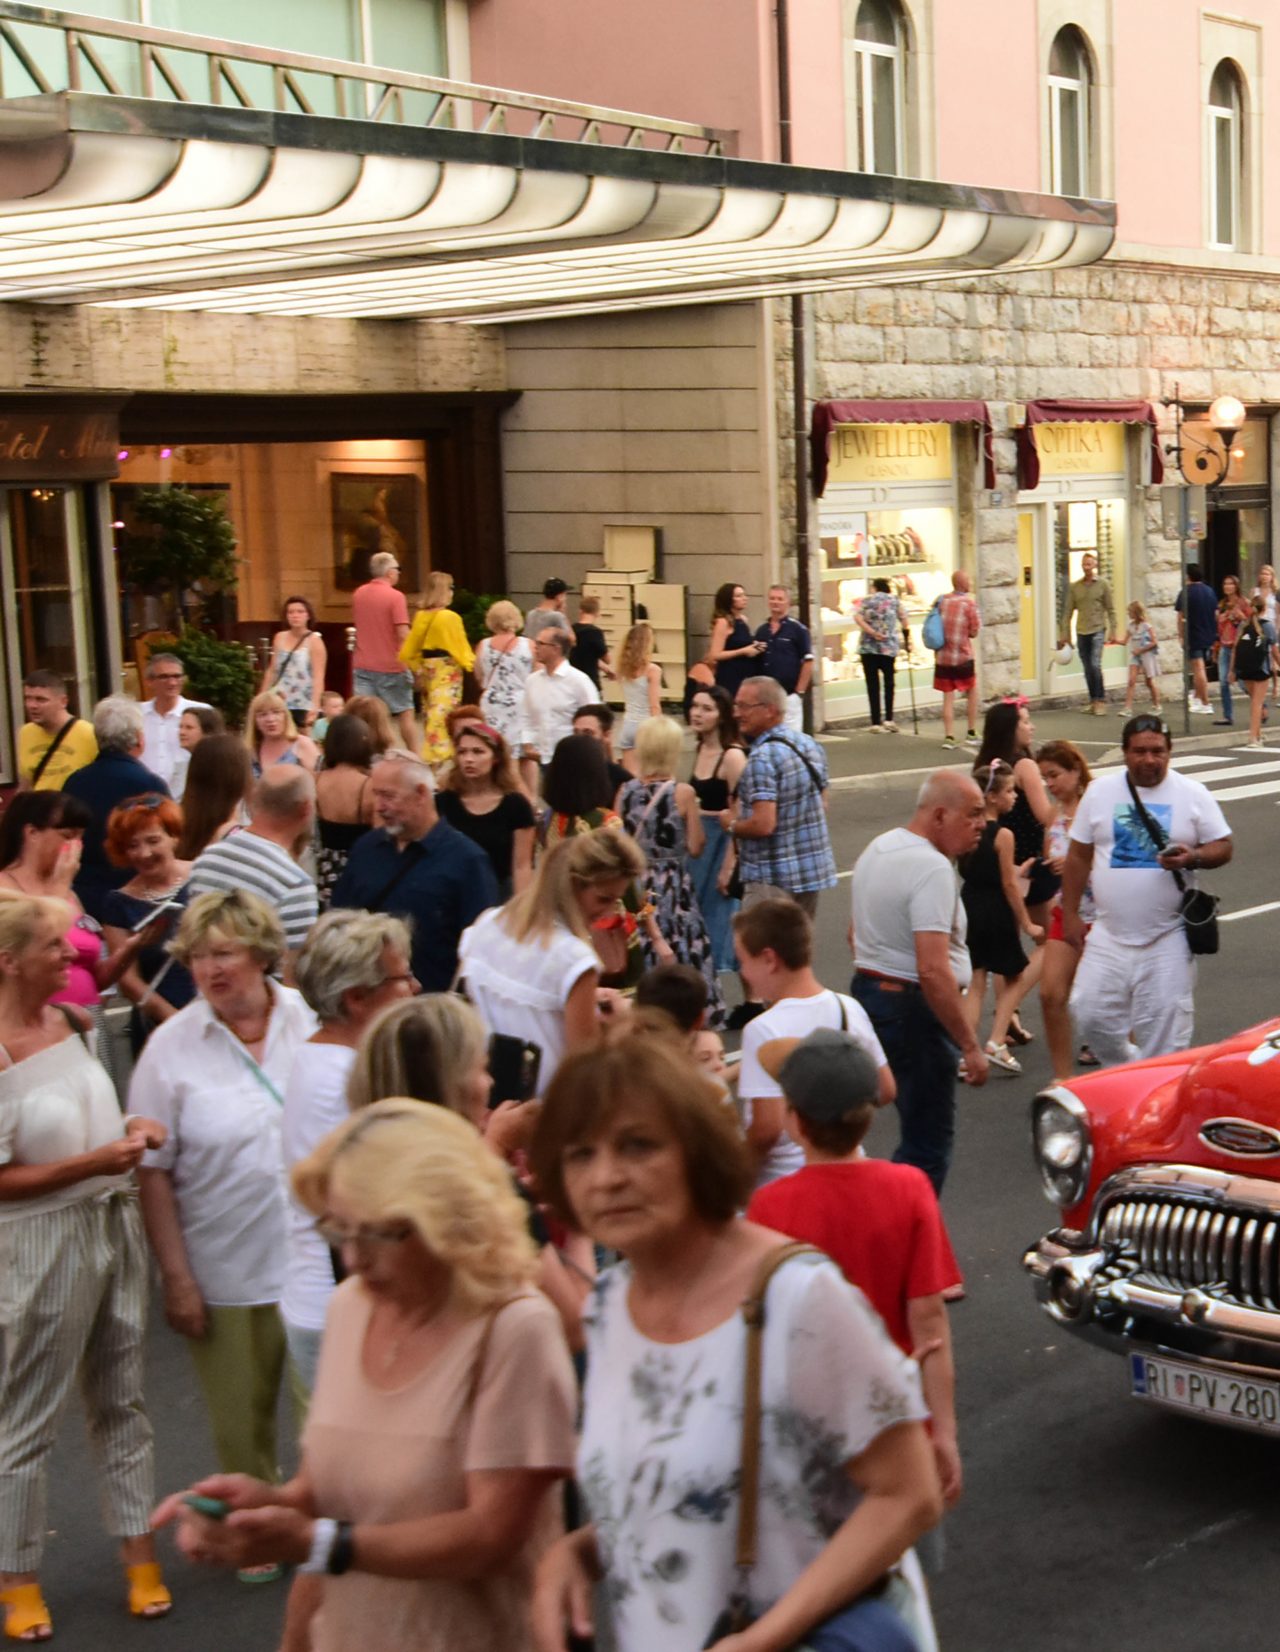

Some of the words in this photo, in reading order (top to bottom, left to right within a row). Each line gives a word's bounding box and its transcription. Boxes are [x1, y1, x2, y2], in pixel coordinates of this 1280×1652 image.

[834, 429, 938, 468] JEWELLERY
[1041, 426, 1104, 453] OPTIKA
[1147, 1363, 1169, 1397] RI
[1189, 1373, 1276, 1421] PV-280
